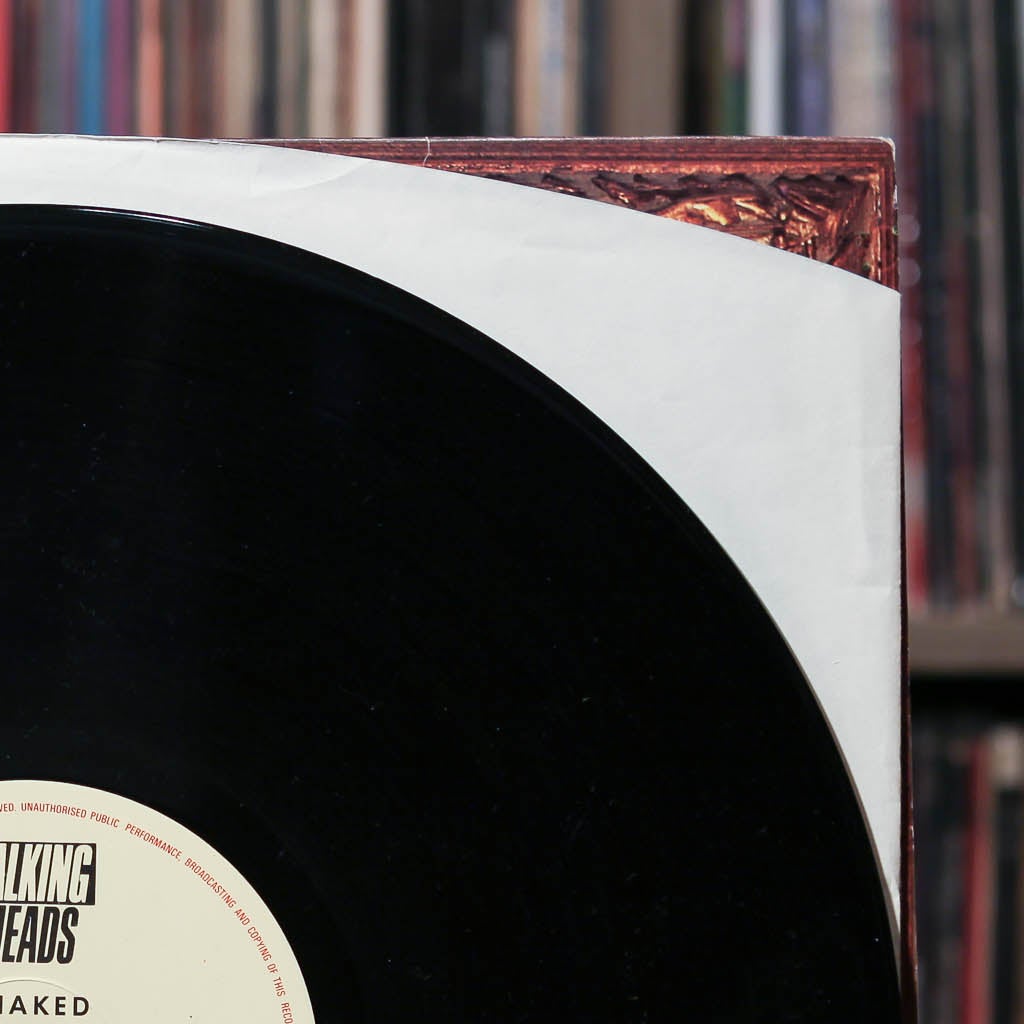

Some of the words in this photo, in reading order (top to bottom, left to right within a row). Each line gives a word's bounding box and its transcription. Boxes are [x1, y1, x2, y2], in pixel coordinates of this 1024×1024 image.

[20, 802, 87, 819] UNAUTHORISED
[89, 811, 120, 828] PUBLIC
[184, 857, 237, 909] BROADCASTING
[233, 908, 251, 926] AND
[247, 926, 272, 962] COPYING
[266, 963, 279, 974] OF
[272, 976, 286, 997] THIS
